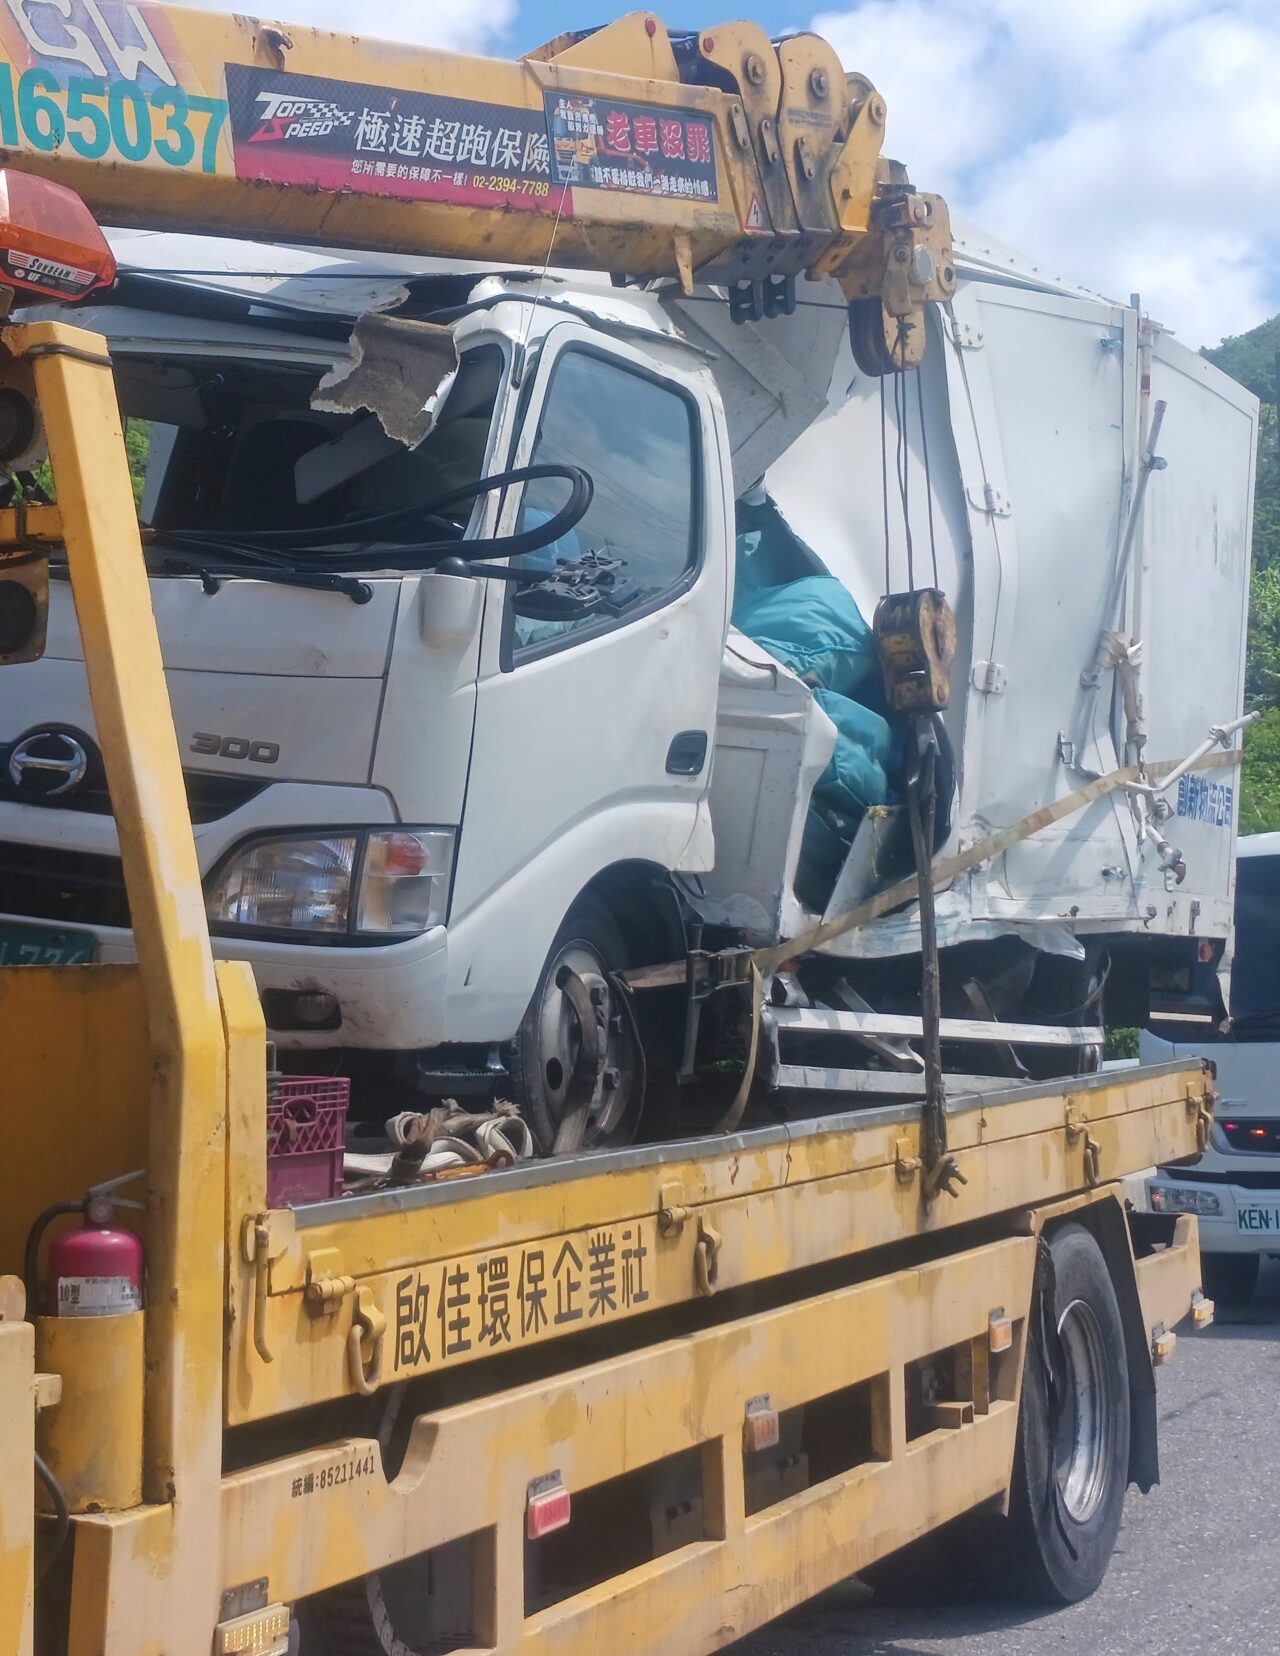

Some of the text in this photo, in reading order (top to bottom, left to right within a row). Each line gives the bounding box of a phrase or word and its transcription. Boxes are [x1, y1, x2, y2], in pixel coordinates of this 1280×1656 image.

[255, 92, 327, 120] TOP
[249, 117, 334, 142] SPEED
[353, 107, 550, 175] 極速超跑保險
[189, 731, 280, 764] 300
[394, 1224, 649, 1372] 啟佳環保企業社
